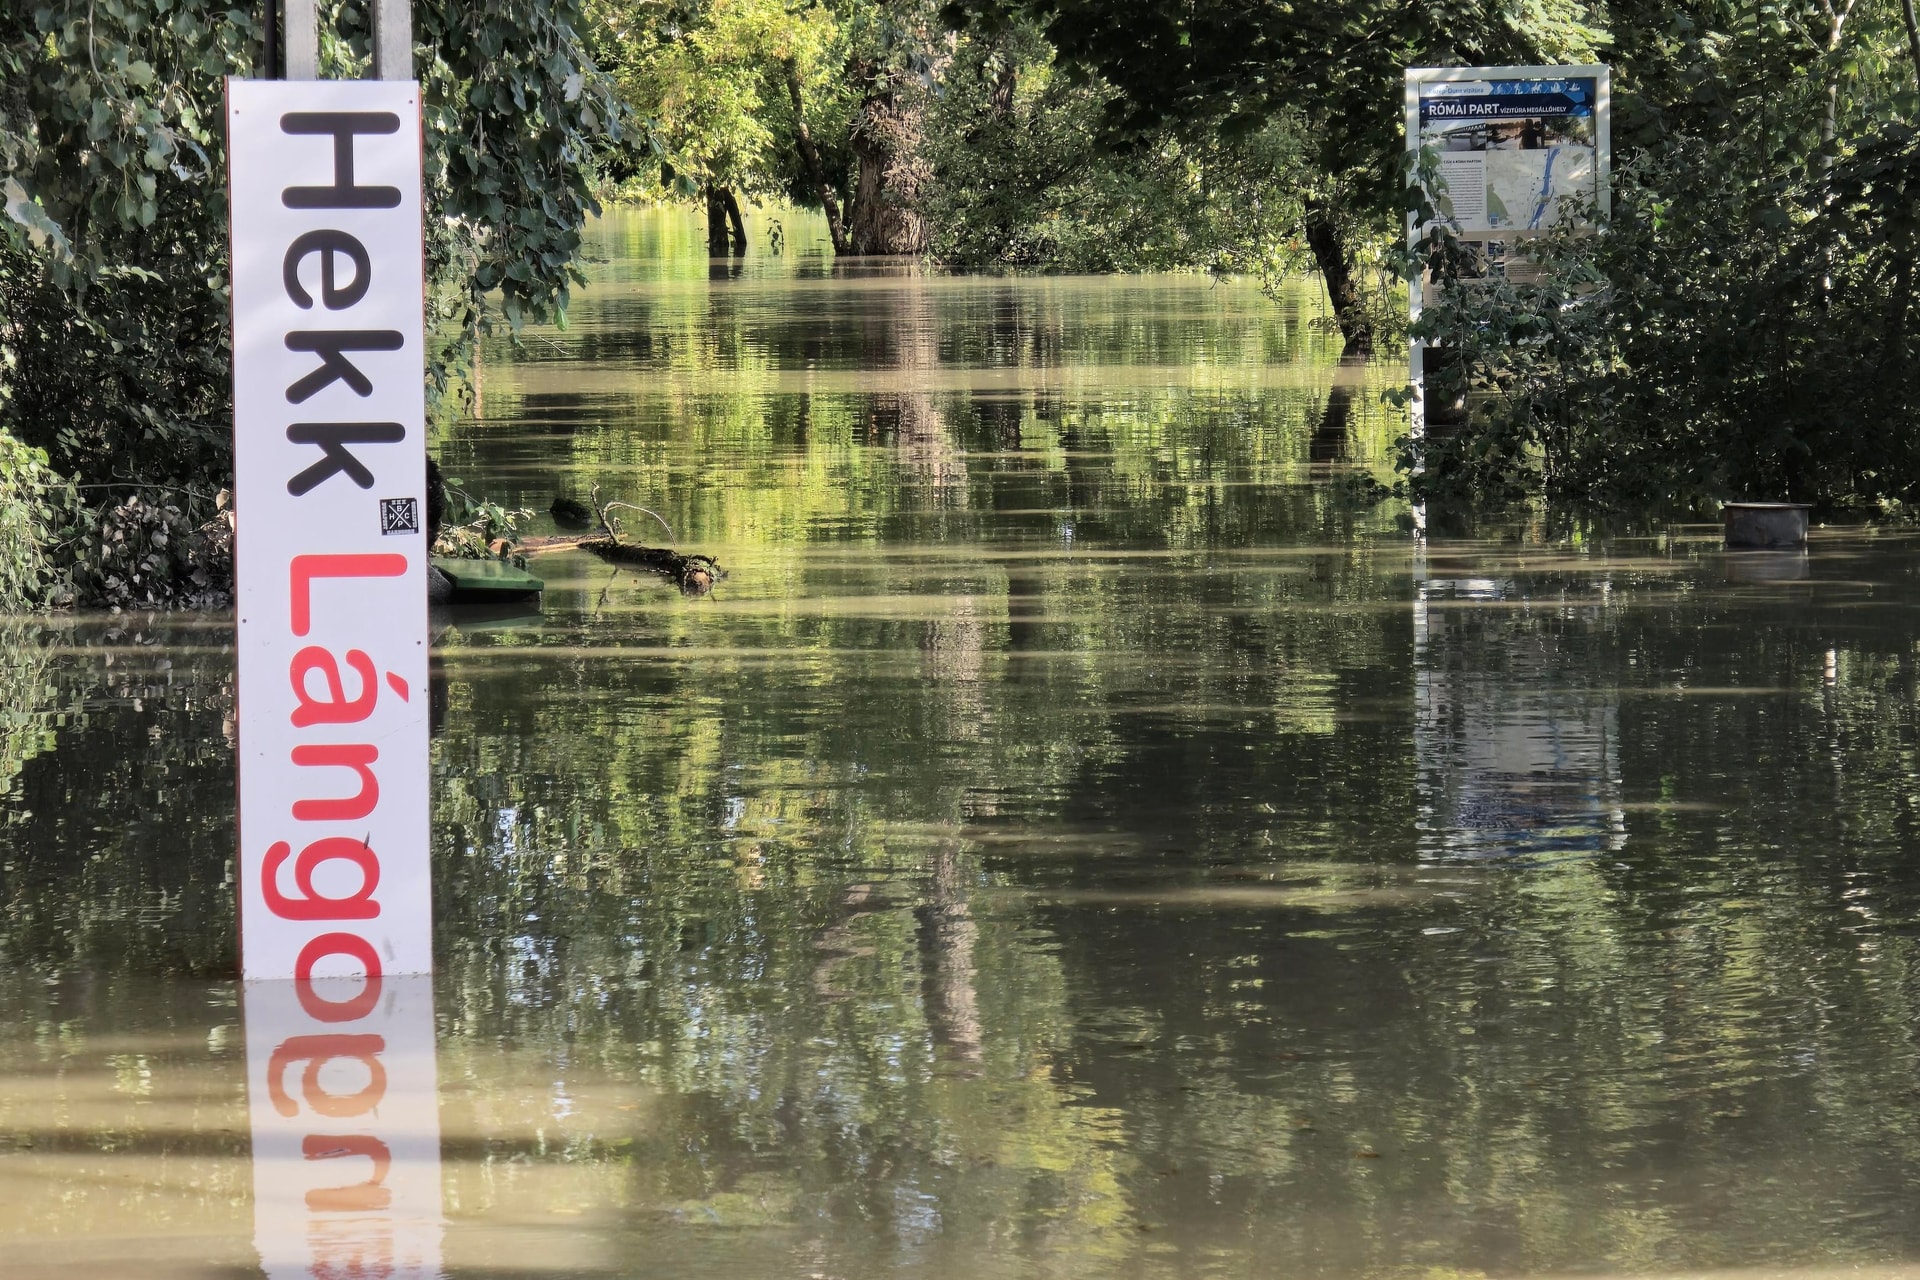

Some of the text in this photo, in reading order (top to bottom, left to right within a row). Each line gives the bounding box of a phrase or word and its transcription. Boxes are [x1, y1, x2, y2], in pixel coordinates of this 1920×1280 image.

[1429, 102, 1467, 116] RÓMAI
[1469, 104, 1500, 115] PART
[280, 112, 406, 497] Hekk
